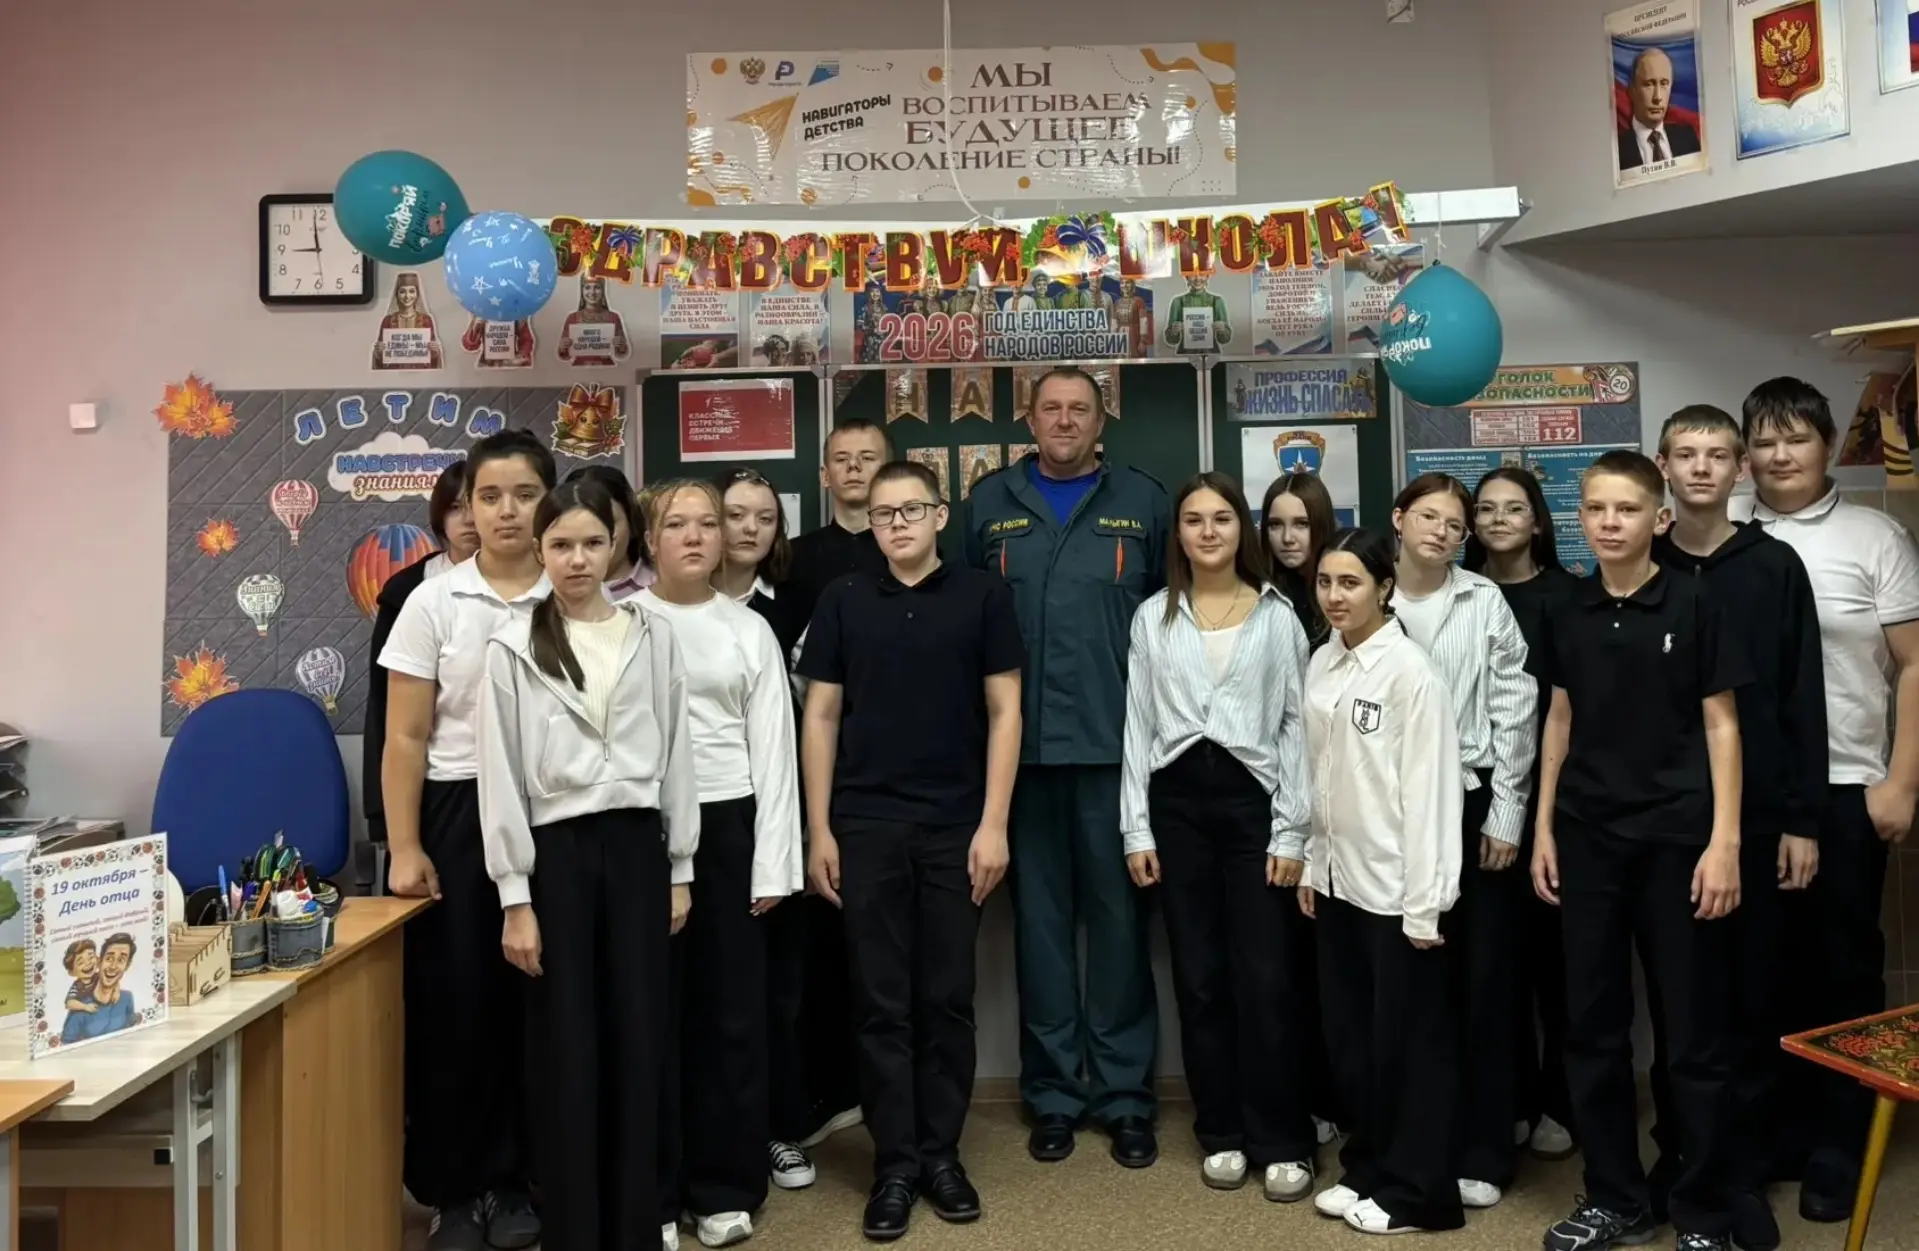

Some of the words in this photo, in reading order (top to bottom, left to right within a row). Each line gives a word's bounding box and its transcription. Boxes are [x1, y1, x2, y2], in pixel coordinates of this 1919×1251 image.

[971, 62, 1052, 88] МЫ
[802, 94, 891, 123] НАВИГАТОРЫ
[902, 92, 1151, 115] ВОСПИТЫВАЕМ
[804, 116, 864, 140] ДЕТСТВА
[906, 115, 1138, 149] БУДУЩЕЕ
[822, 150, 1025, 172] ПОКОЛЕНИЕ
[274, 224, 291, 236] 10
[277, 244, 286, 255] 9
[279, 264, 287, 276] 8
[352, 264, 359, 274] 4
[295, 279, 302, 290] 7
[314, 279, 323, 290] 6
[336, 278, 344, 290] 5
[984, 311, 1017, 334] ГОД
[1022, 310, 1107, 332] ЕДИНСТВА
[880, 313, 975, 360] 2026
[984, 335, 1061, 359] НАРОДОВ
[1064, 334, 1128, 356] РОССИИ
[1254, 368, 1347, 387] ПРОФЕССИЯ
[1499, 371, 1554, 384] ГОЛОК
[1613, 379, 1629, 390] 20
[1477, 385, 1590, 400] ОПАСНОСТИ
[298, 393, 502, 441] ЛЕТИМ
[1543, 427, 1577, 441] 112
[51, 881, 69, 896] 19
[72, 869, 136, 891] октября
[58, 898, 97, 917] День
[100, 888, 140, 905] отца
